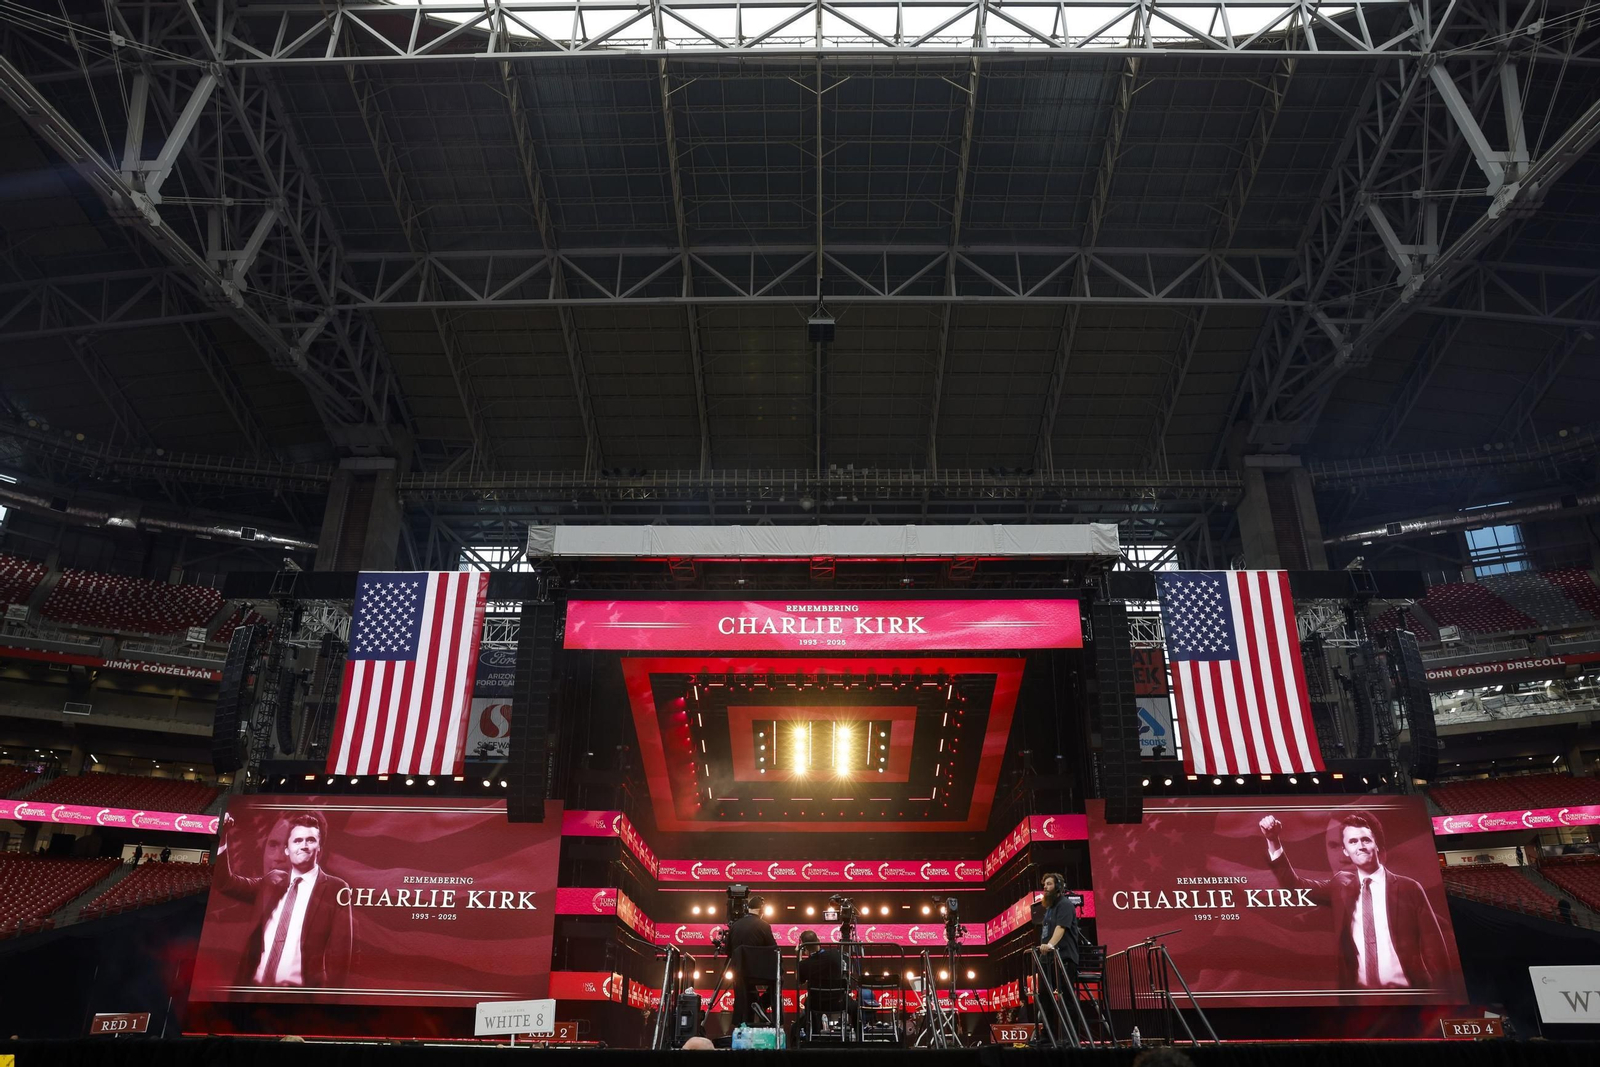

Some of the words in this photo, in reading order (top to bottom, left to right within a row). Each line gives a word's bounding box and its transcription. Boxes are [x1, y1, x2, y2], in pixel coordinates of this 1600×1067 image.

[718, 616, 843, 635] CHARLIE
[854, 616, 927, 634] KIRK
[102, 660, 140, 671] JIMMY
[142, 664, 212, 679] CONZELMAN
[1455, 664, 1504, 677] (PADDY)
[1507, 657, 1566, 671] DRISCOLL
[476, 679, 497, 687] FORD
[403, 876, 474, 885] REMEMBERING
[1176, 876, 1248, 885] REMEMBERING
[336, 887, 456, 908] CHARLIE
[466, 890, 537, 910] KIRK
[1112, 889, 1236, 910] CHARLIE
[1244, 888, 1317, 908] KIRK
[438, 913, 457, 921] 2025
[1558, 990, 1600, 1013] W
[101, 1019, 128, 1031] RED
[131, 1019, 137, 1029] 1
[484, 1014, 531, 1029] WHITE
[536, 1013, 544, 1027] 8
[560, 1028, 568, 1038] 2
[1001, 1030, 1028, 1040] RED
[1452, 1024, 1481, 1035] RED
[1485, 1023, 1494, 1034] 4
